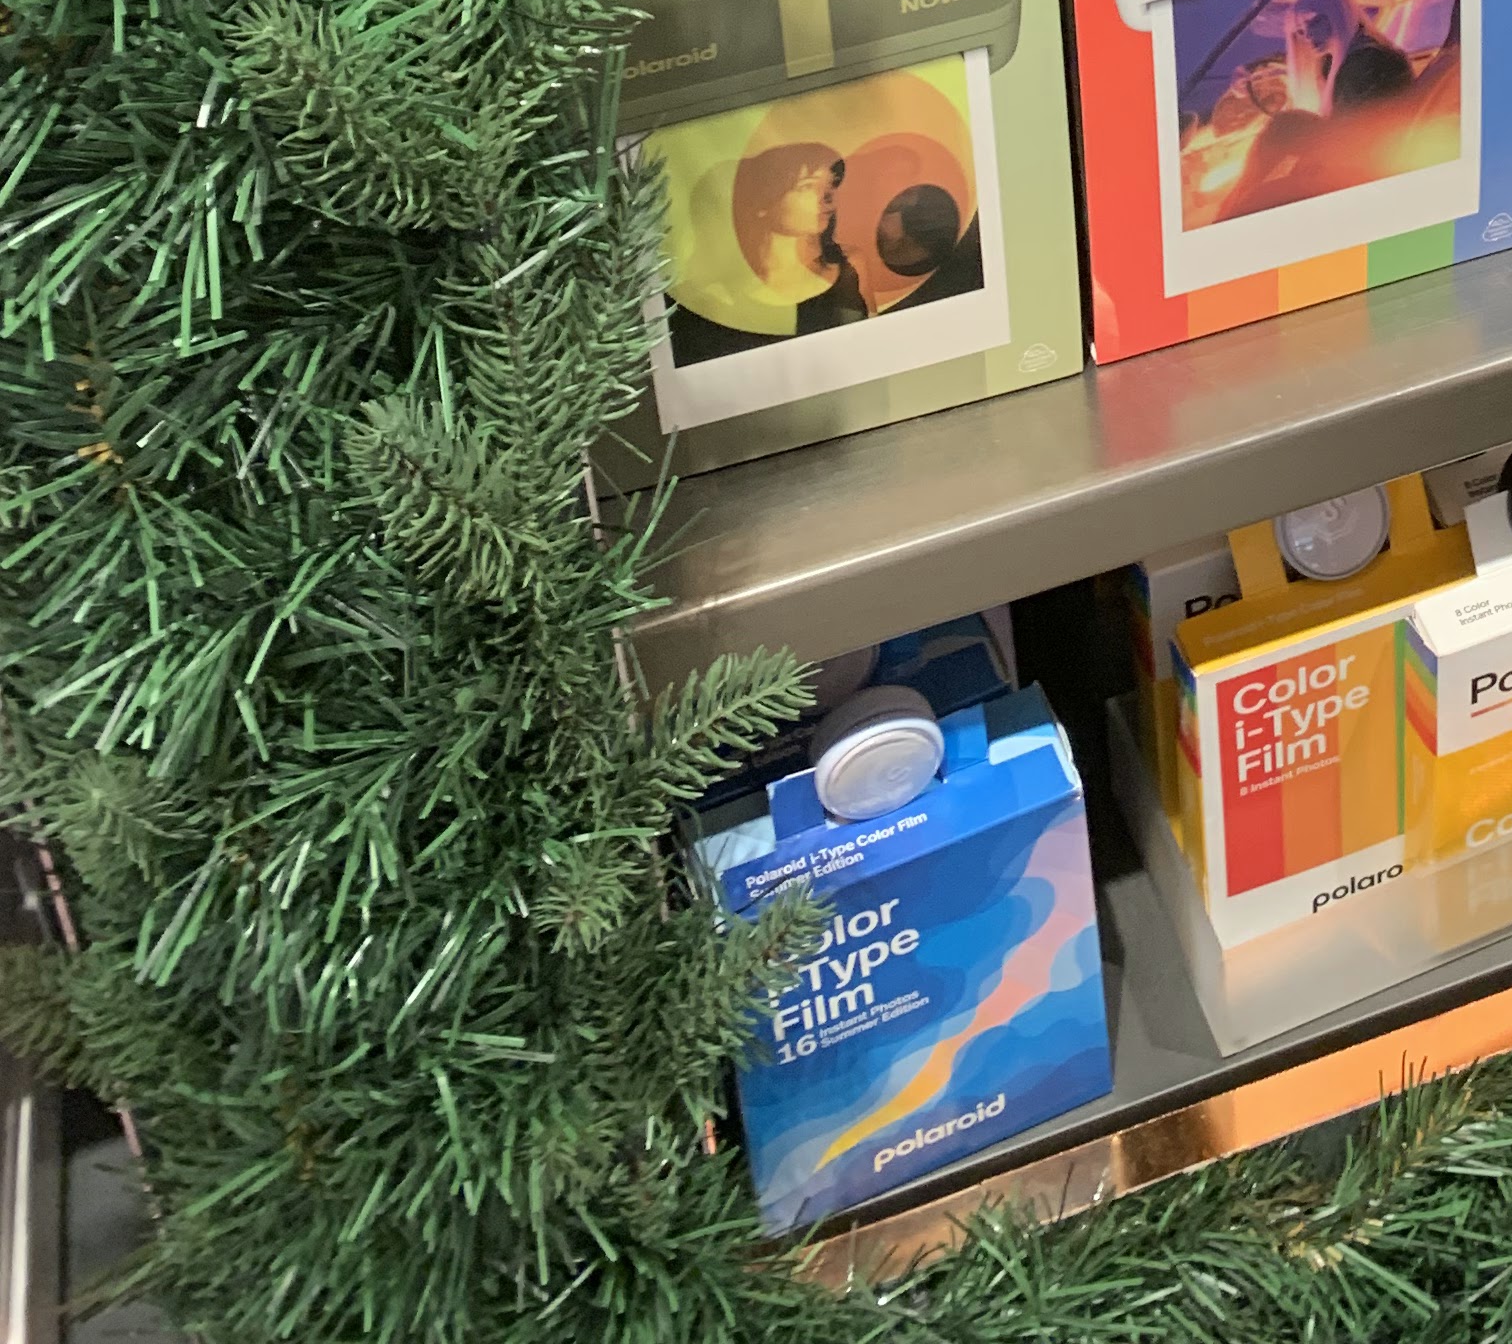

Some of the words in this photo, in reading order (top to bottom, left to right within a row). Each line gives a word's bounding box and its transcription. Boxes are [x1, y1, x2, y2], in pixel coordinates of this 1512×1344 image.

[619, 42, 718, 83] olaroid
[1454, 608, 1462, 618] 8
[1463, 599, 1490, 615] Color
[1459, 609, 1494, 626] Instant
[1233, 655, 1356, 715] Color
[1235, 685, 1370, 751] i-Type
[1237, 732, 1327, 783] Film
[1239, 786, 1249, 798] 8
[1249, 770, 1294, 793] Instant
[745, 857, 806, 890] Polaroid
[809, 841, 856, 868] i-Type
[856, 824, 896, 847] Color
[897, 811, 928, 832] Film
[814, 851, 865, 878] Edition
[1312, 863, 1404, 914] polaro
[773, 982, 875, 1043] Film
[776, 1033, 818, 1066] 16
[819, 1011, 868, 1039] Instant
[869, 990, 919, 1016] Photos
[820, 1018, 879, 1049] Summer
[881, 995, 930, 1022] Edition
[873, 1092, 1006, 1174] polaroid
